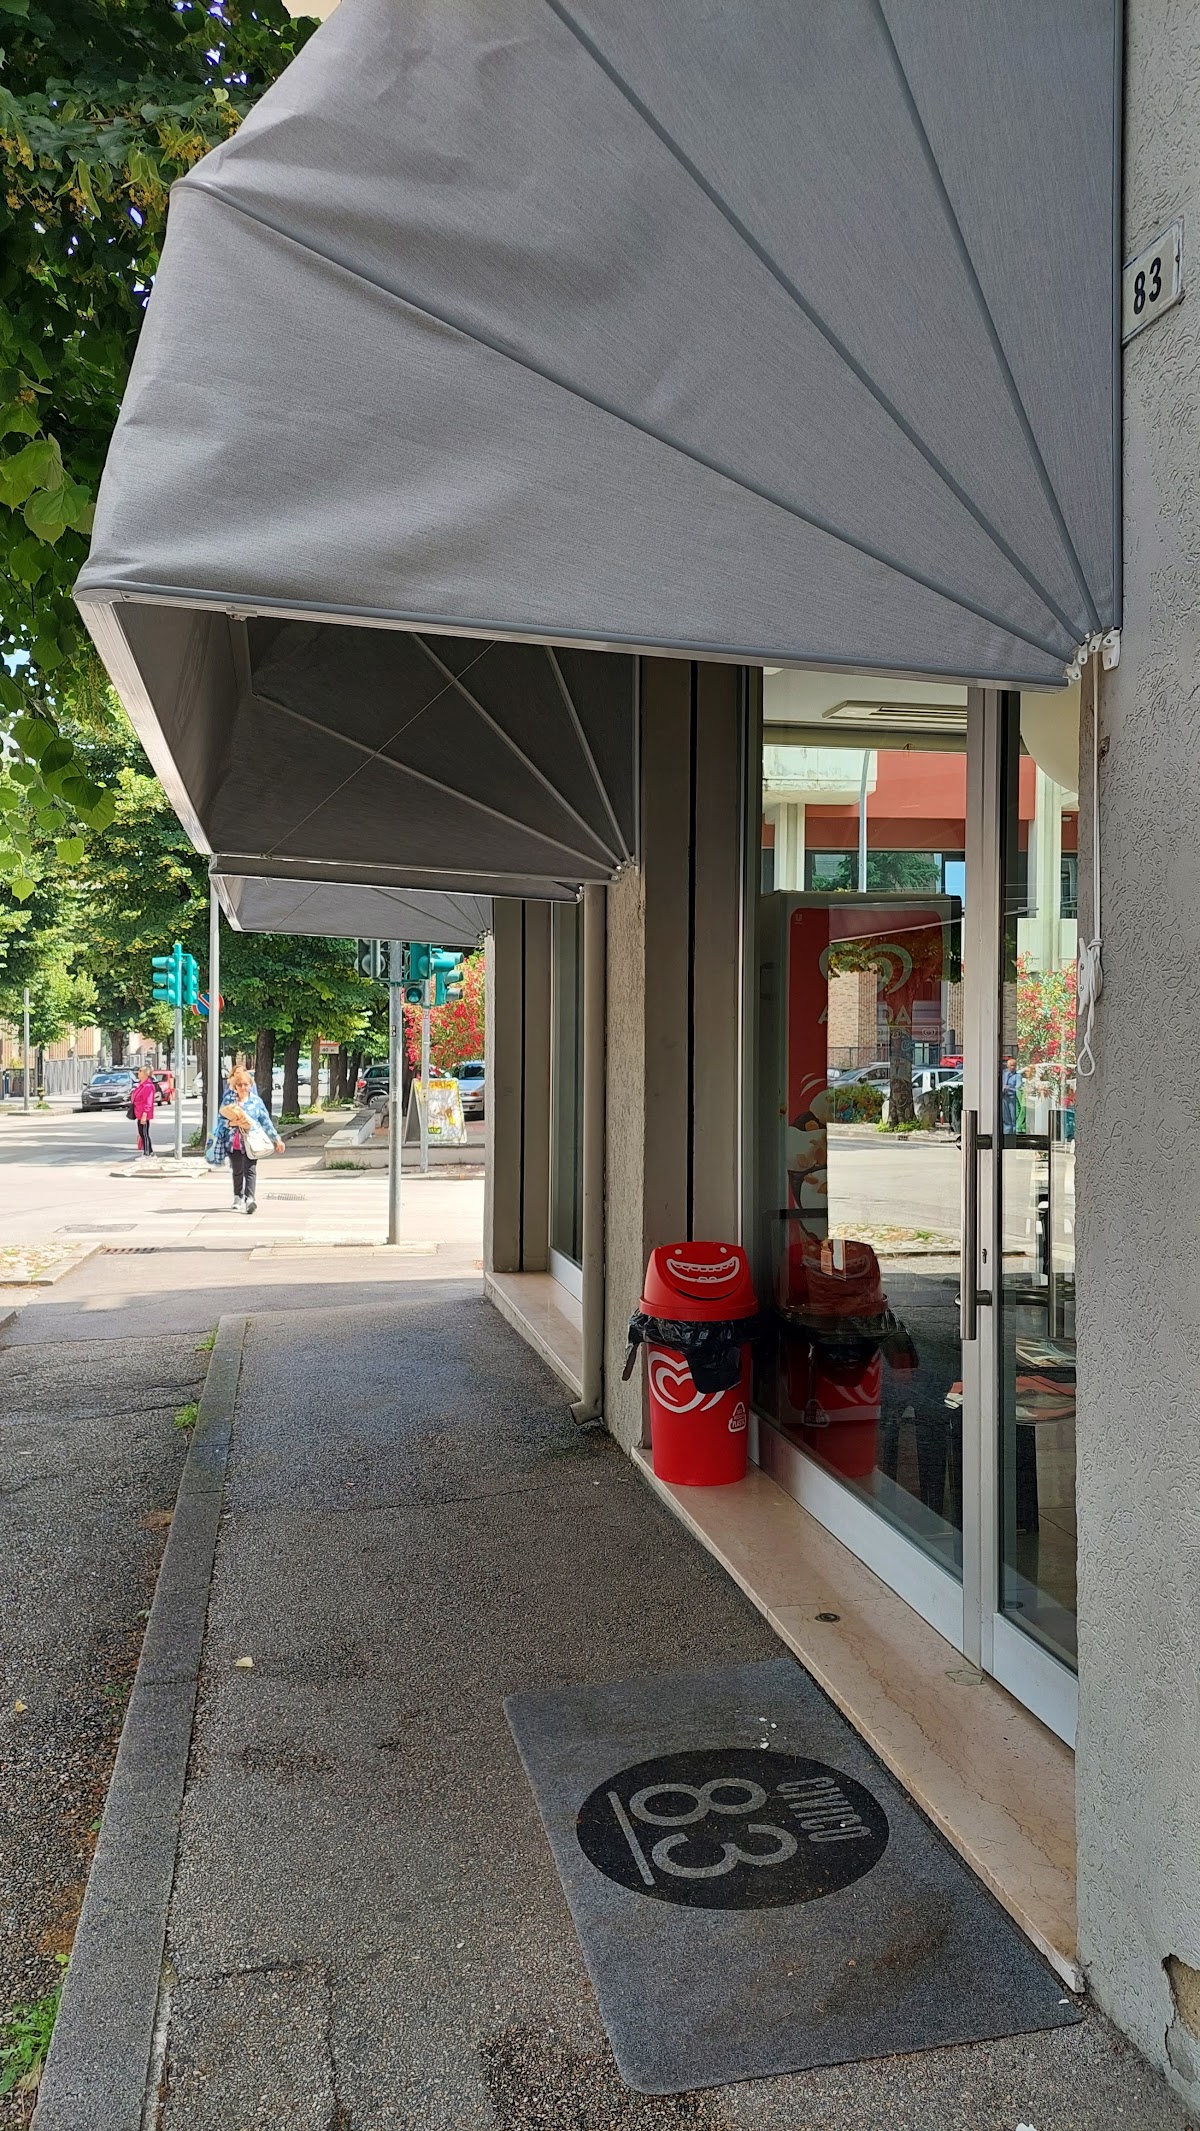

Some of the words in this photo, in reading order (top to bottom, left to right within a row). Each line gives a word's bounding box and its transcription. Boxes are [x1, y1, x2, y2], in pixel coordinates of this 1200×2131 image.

[1133, 257, 1162, 315] 83
[629, 1777, 799, 1879] 83
[776, 1776, 872, 1843] CIVICO
